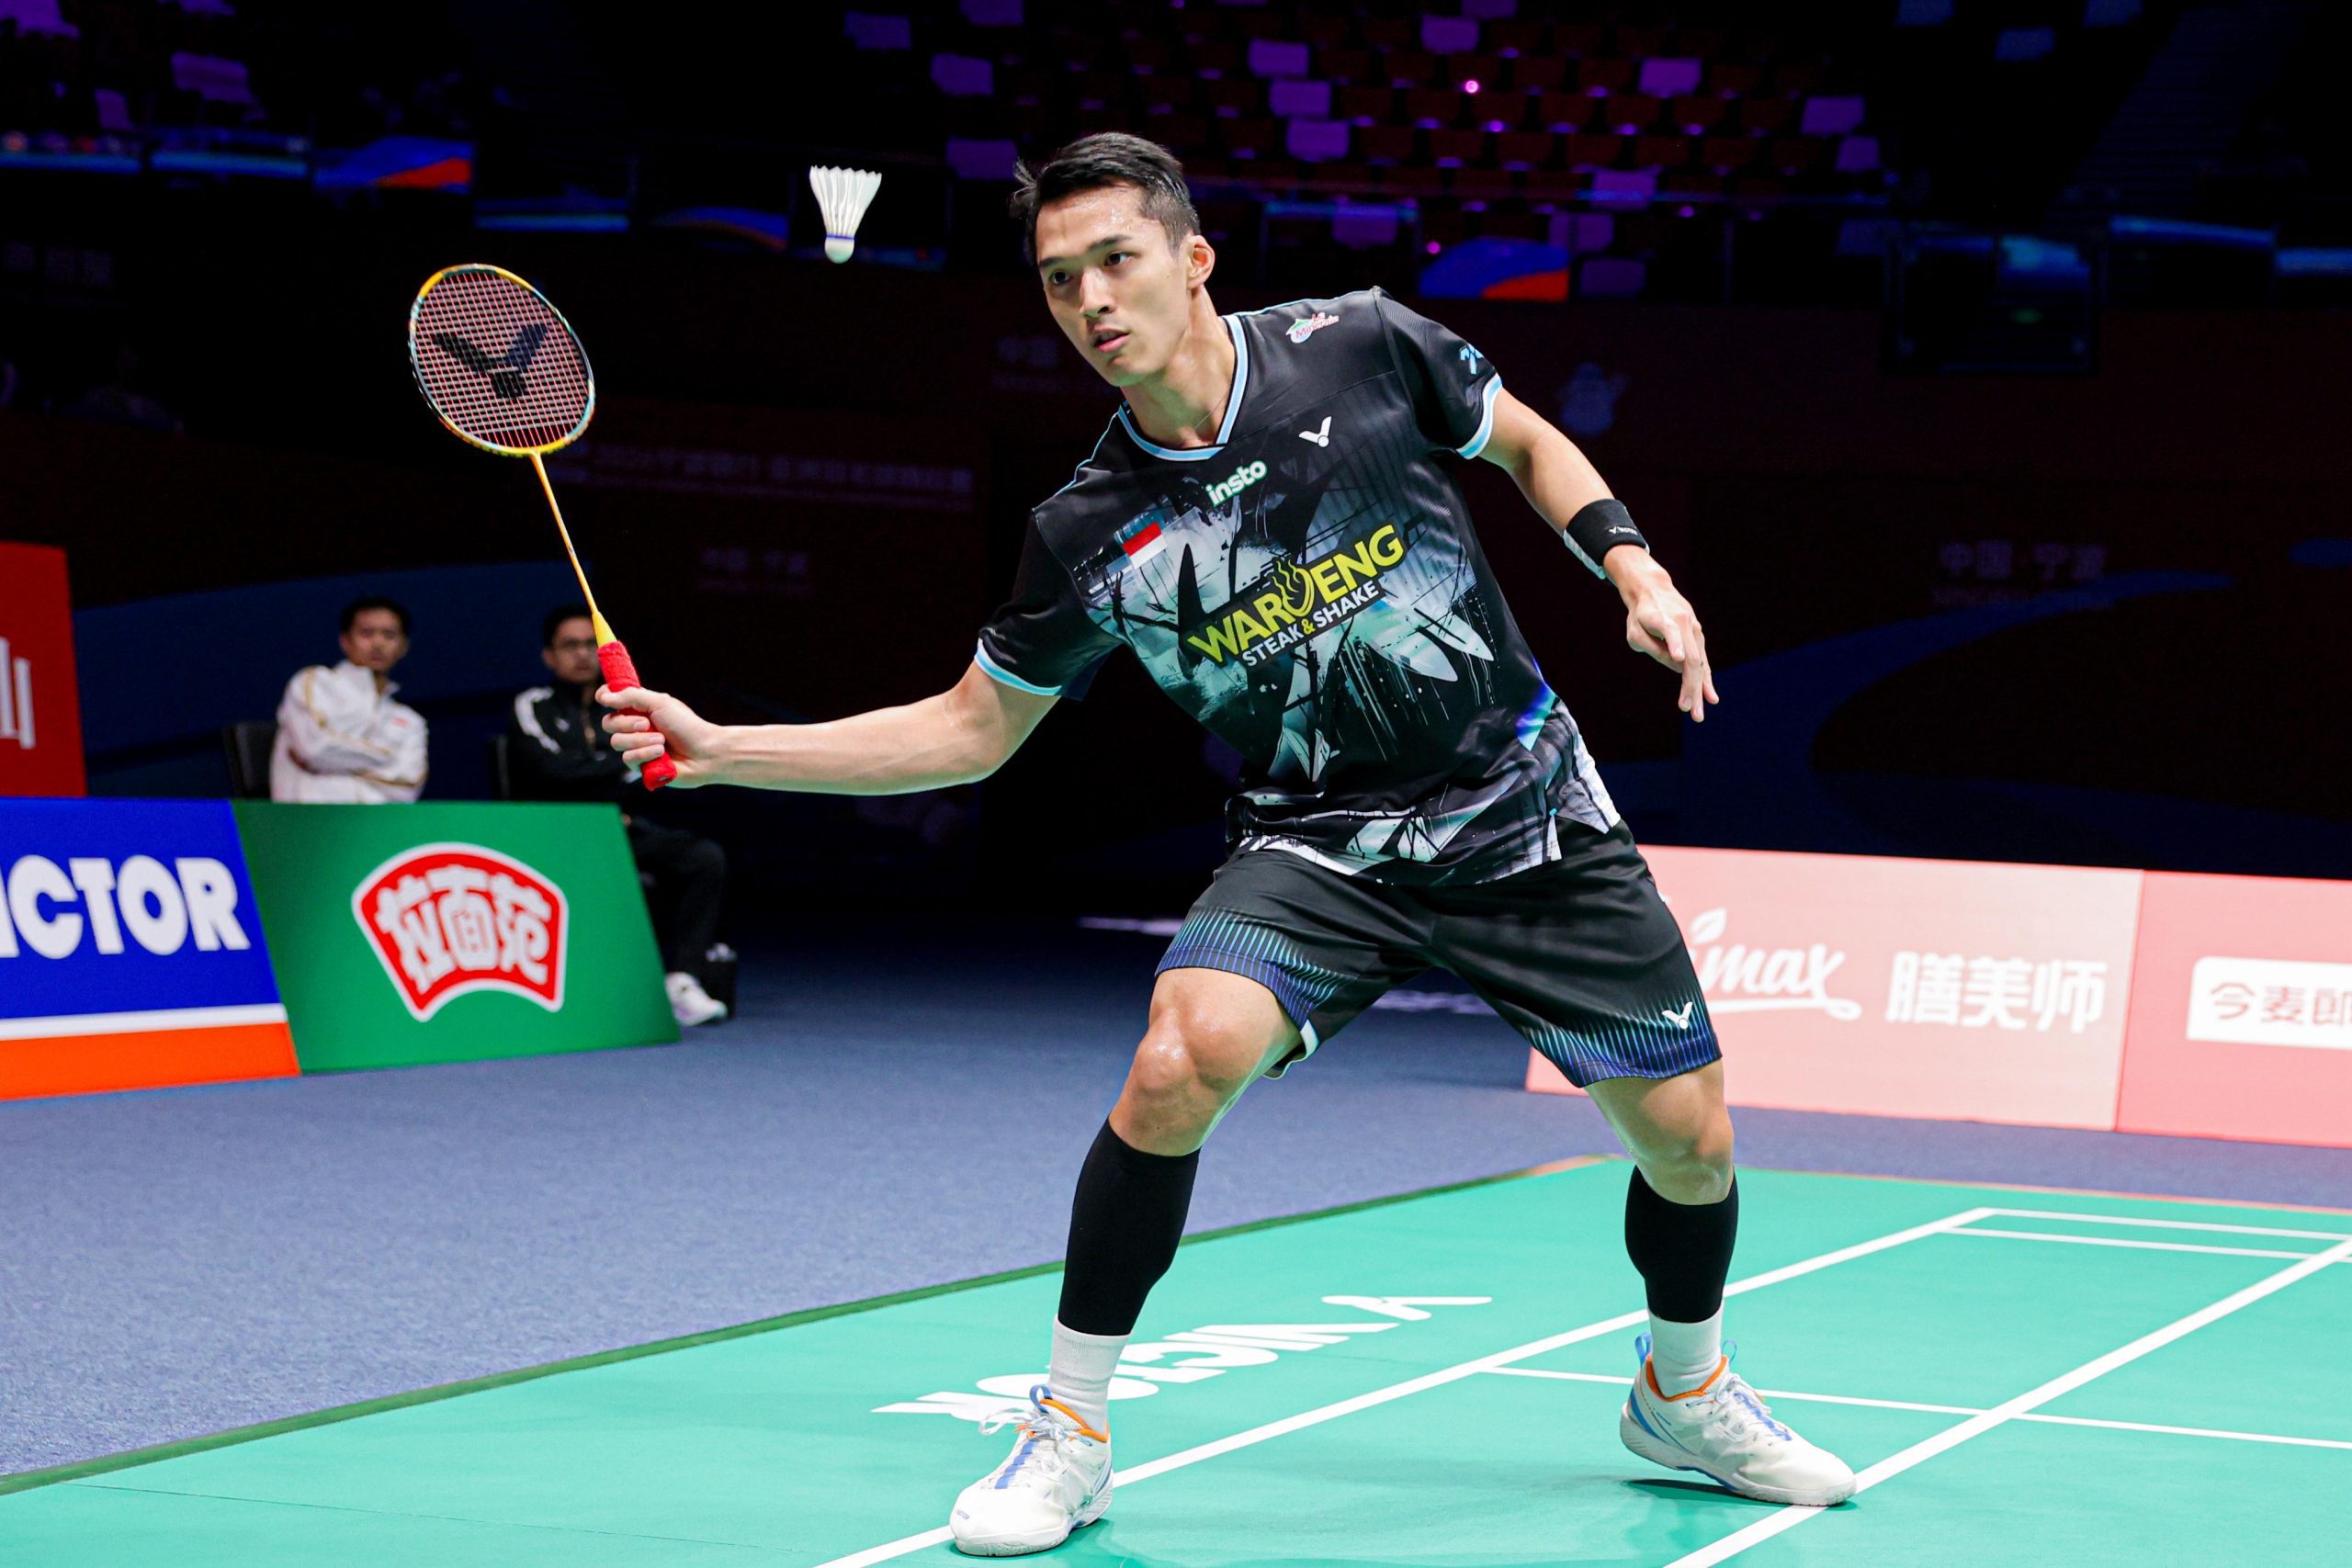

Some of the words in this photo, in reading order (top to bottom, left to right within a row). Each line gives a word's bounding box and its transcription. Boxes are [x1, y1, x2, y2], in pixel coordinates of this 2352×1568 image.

[1205, 459, 1267, 506] insto
[1884, 951, 2108, 1034] 膳美师
